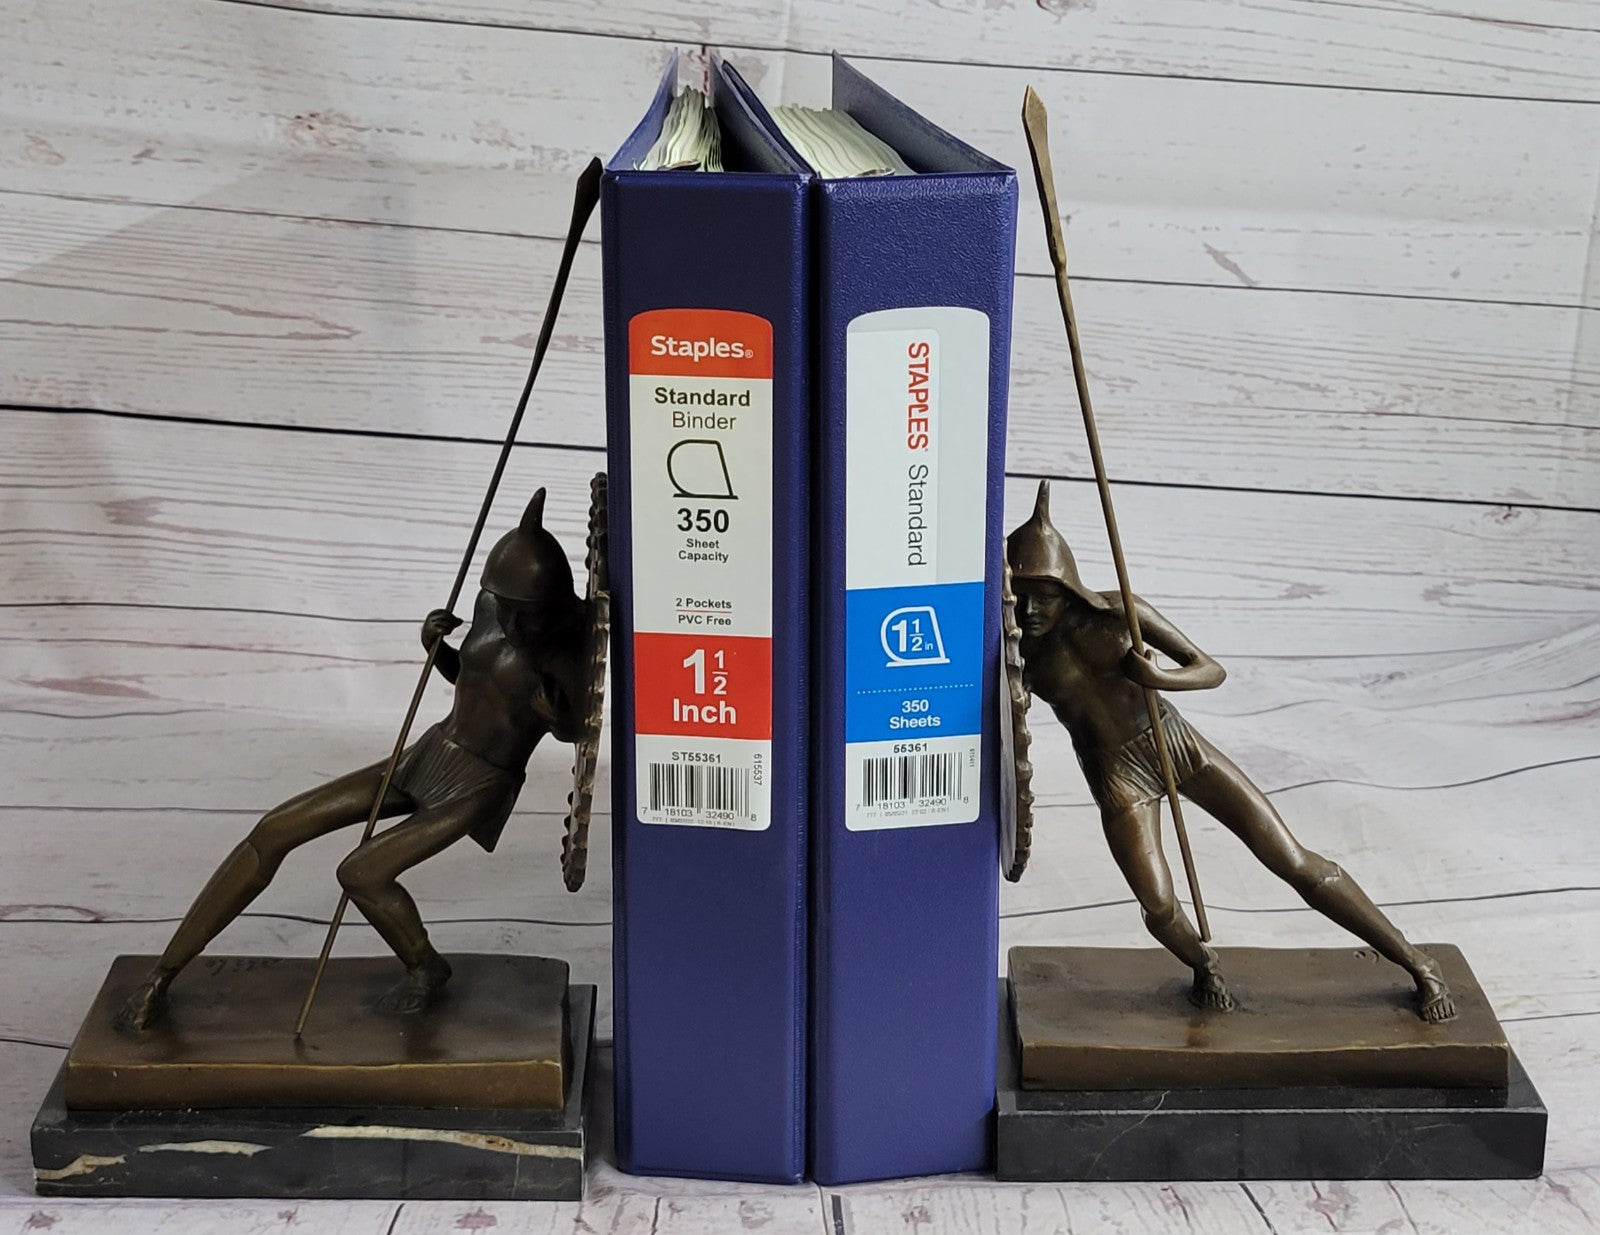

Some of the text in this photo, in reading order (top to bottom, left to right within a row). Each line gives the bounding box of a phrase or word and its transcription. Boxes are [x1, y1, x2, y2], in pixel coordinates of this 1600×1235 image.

[654, 387, 751, 407] Standard
[672, 411, 737, 430] Binder
[907, 342, 930, 566] STAPLES Standard
[677, 508, 730, 533] 350
[686, 538, 720, 549] Sheet
[678, 550, 729, 563] Capacity
[675, 598, 732, 609] 2 Pockets
[678, 614, 732, 626] PVC Free
[673, 698, 737, 725] Inch
[901, 699, 930, 713] 350
[889, 716, 941, 729] Sheets
[893, 743, 928, 753] 55361
[671, 751, 721, 763] ST55361
[753, 753, 763, 786] 615537
[877, 801, 906, 810] 18103
[918, 797, 947, 807] 32490
[963, 796, 969, 804] 8
[641, 806, 757, 822] 7 18103 32490 8
